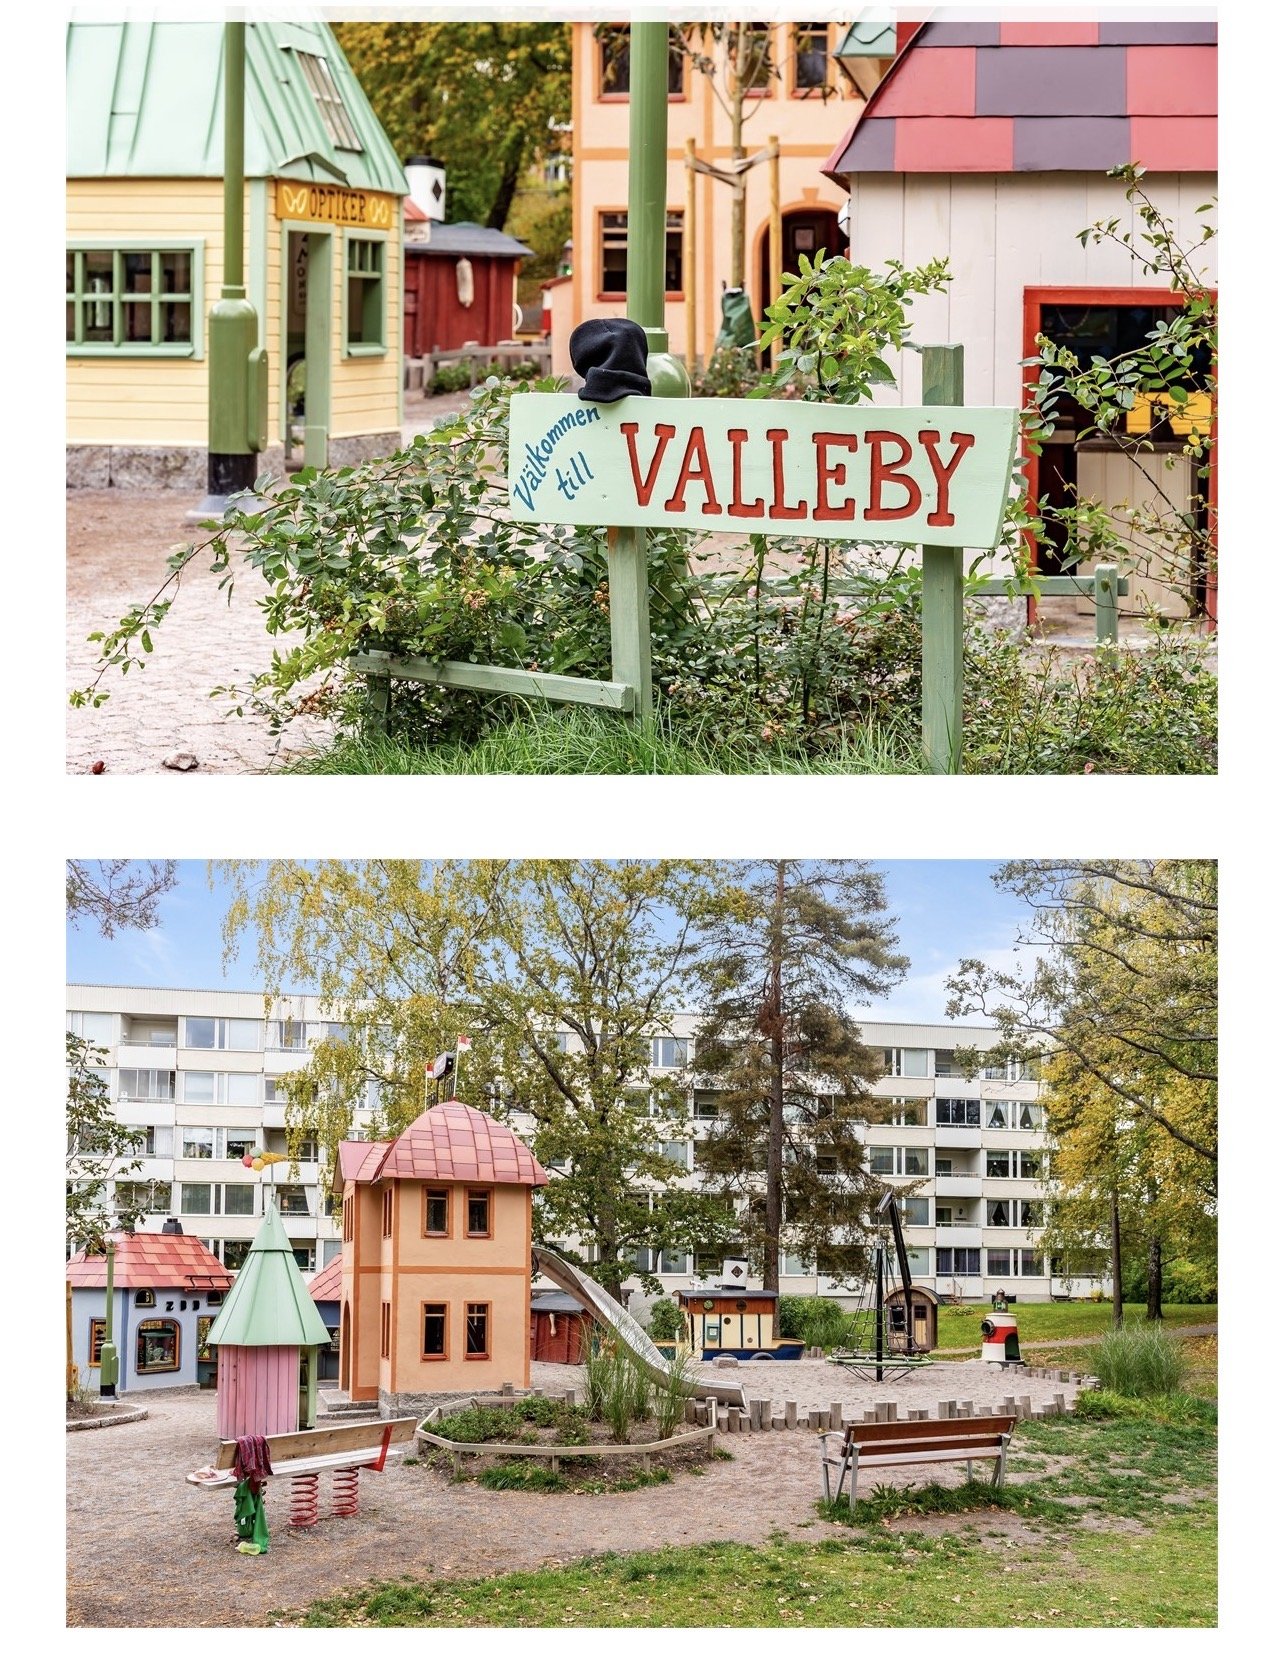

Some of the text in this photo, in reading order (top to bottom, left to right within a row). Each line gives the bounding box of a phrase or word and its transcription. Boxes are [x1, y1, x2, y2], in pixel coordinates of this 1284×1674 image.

[310, 187, 366, 222] OPTIKER
[514, 407, 600, 511] Välkommen
[557, 451, 594, 500] till
[620, 422, 975, 526] VALLEBY
